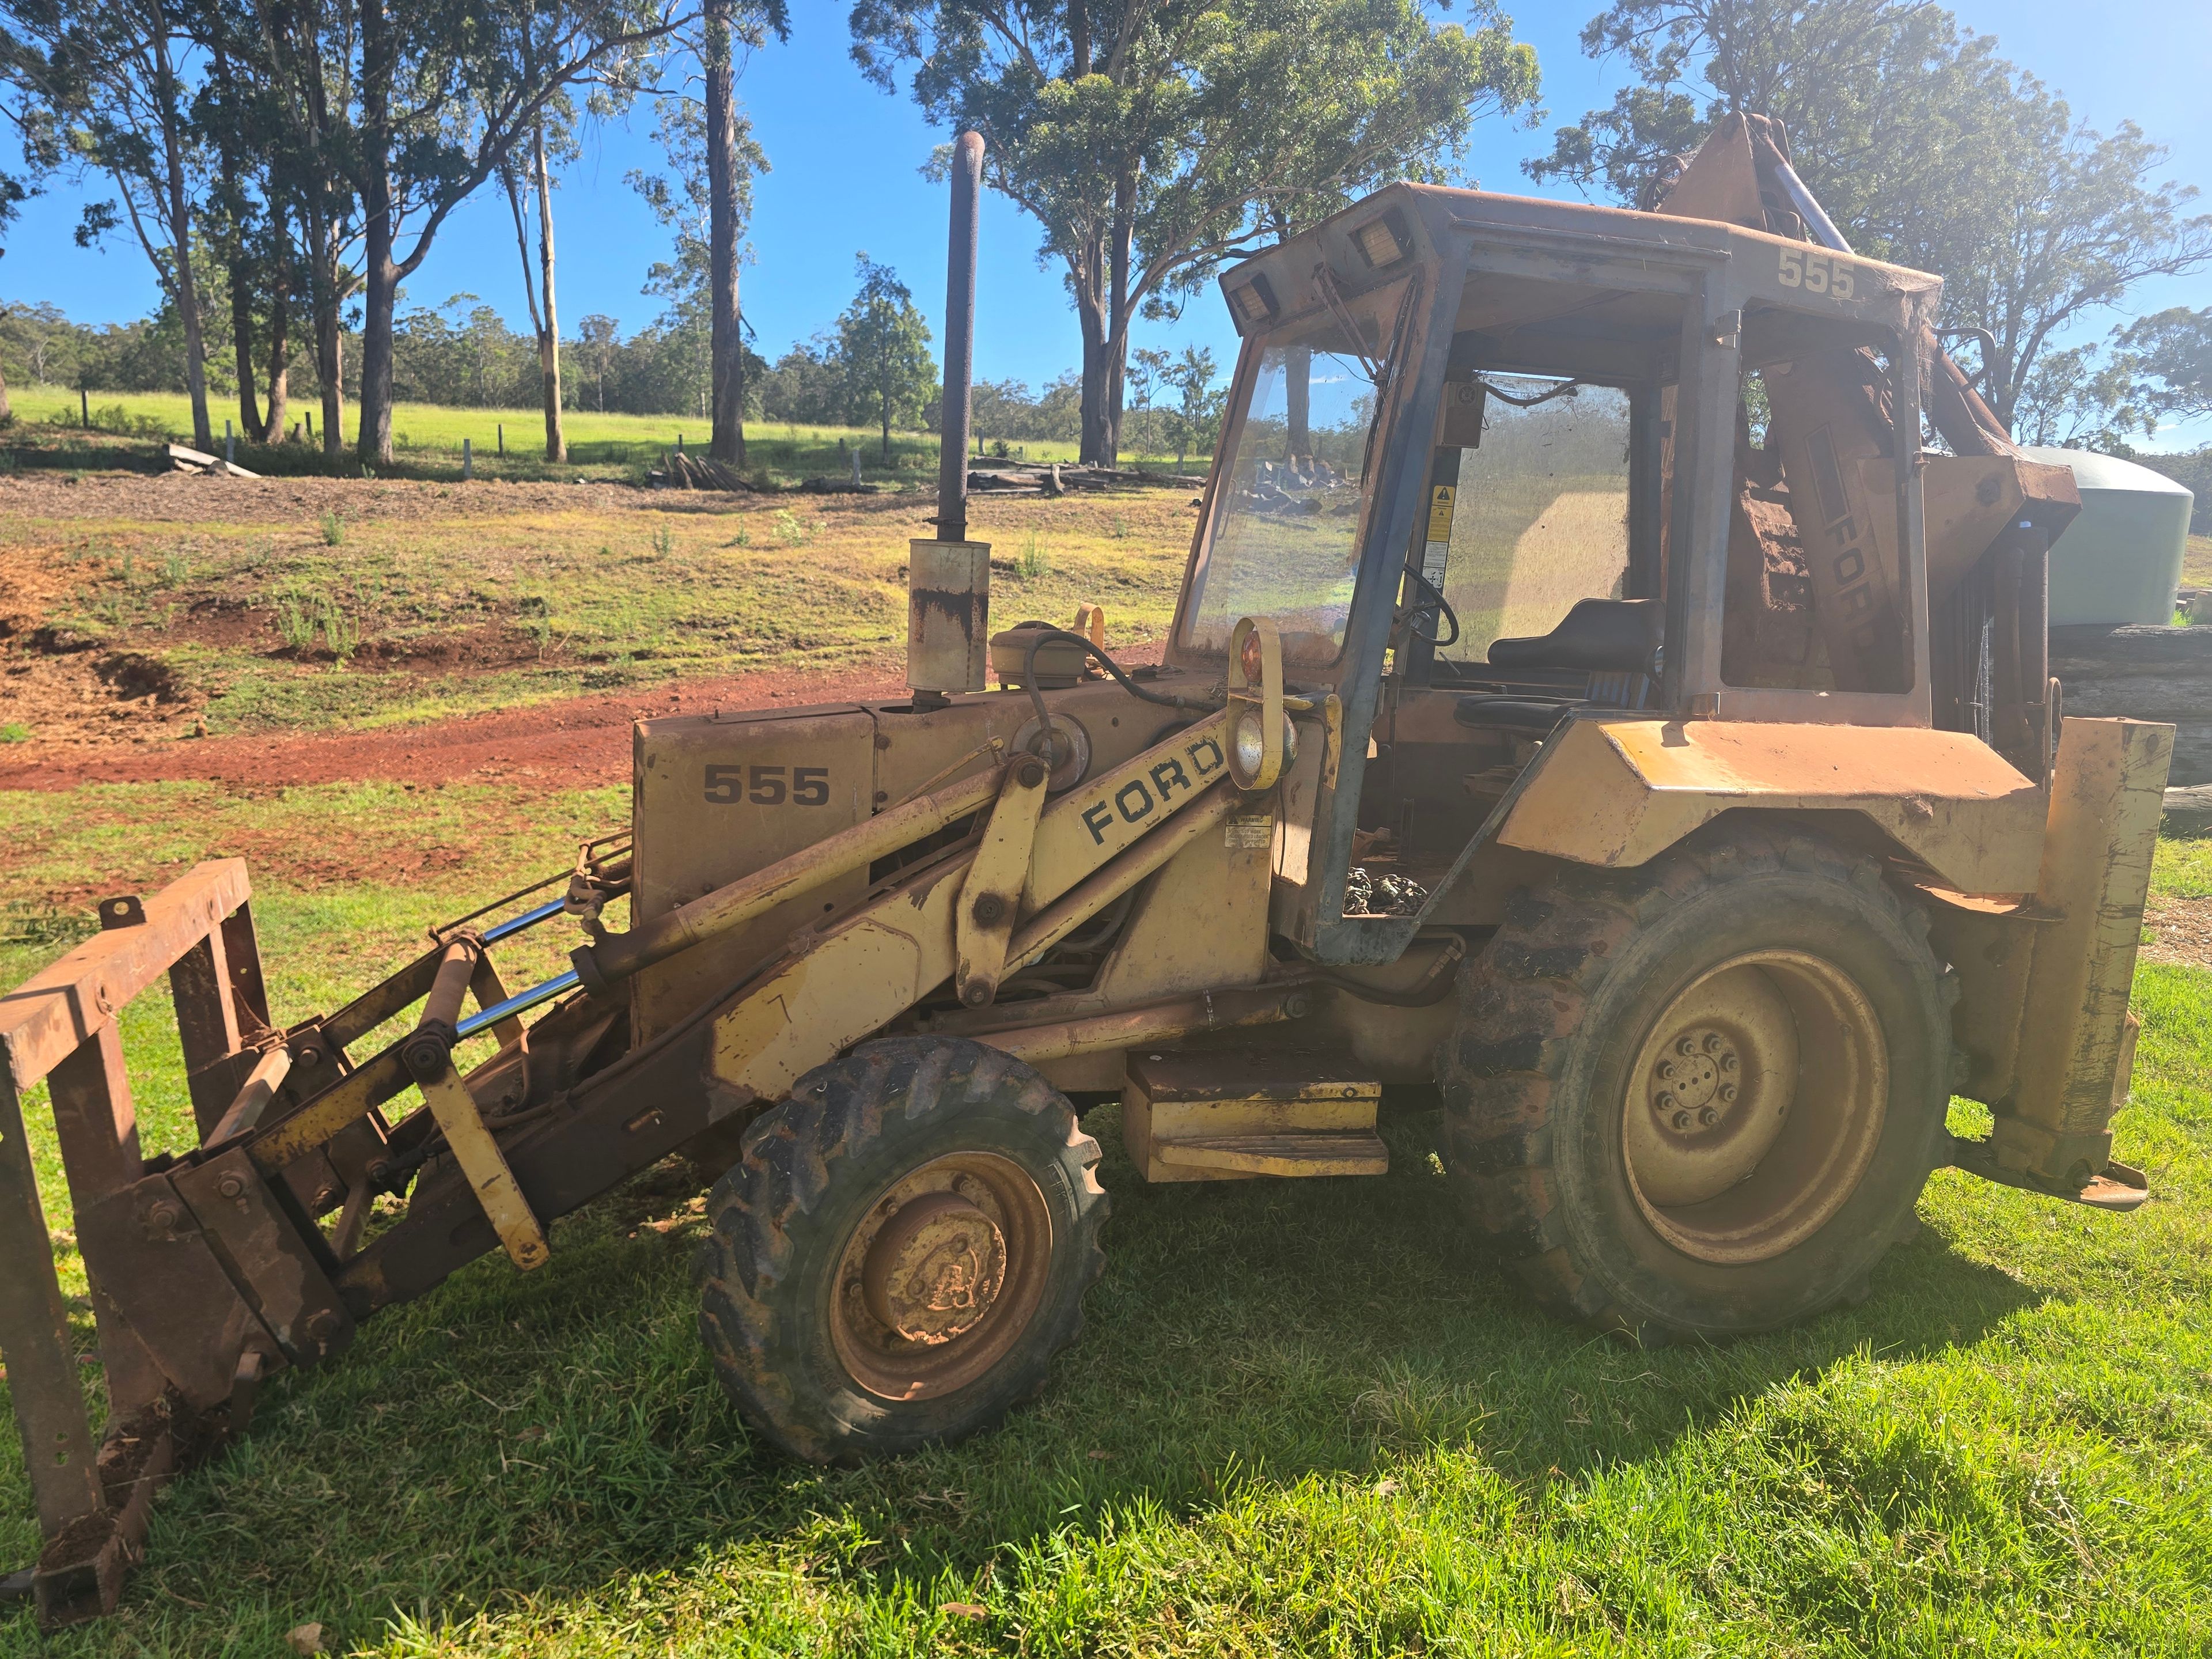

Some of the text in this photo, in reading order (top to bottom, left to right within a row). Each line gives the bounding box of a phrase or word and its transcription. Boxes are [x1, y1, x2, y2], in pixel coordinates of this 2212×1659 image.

[1778, 246, 1854, 299] 555
[704, 764, 829, 806] 555
[1081, 737, 1224, 846] FORD
